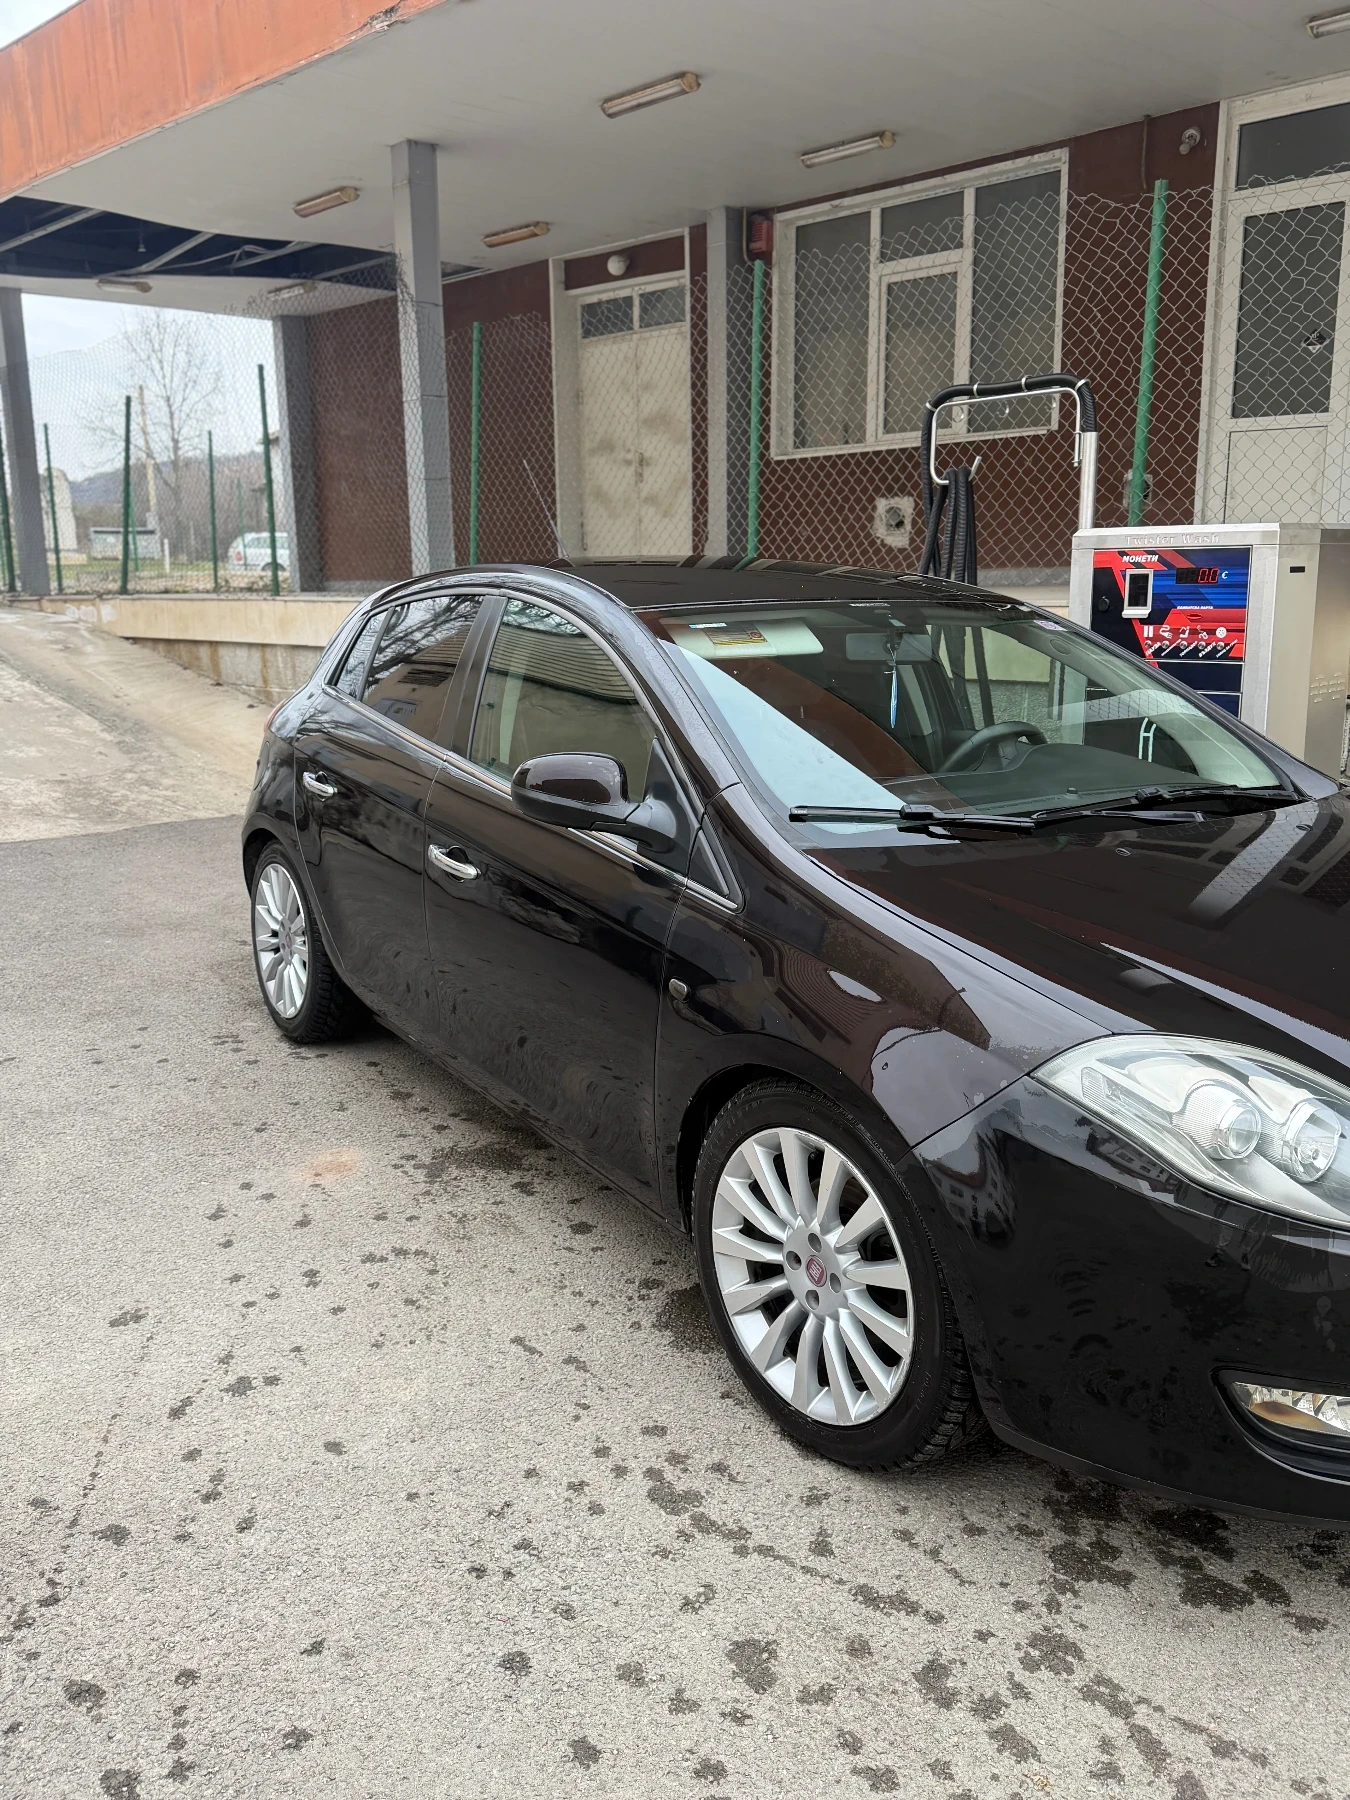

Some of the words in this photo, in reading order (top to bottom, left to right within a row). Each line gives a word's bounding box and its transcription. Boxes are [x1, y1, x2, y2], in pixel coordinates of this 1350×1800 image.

[1125, 535, 1176, 545] Twister
[1182, 533, 1219, 544] Wash
[1122, 555, 1159, 563] МОНЕТИ
